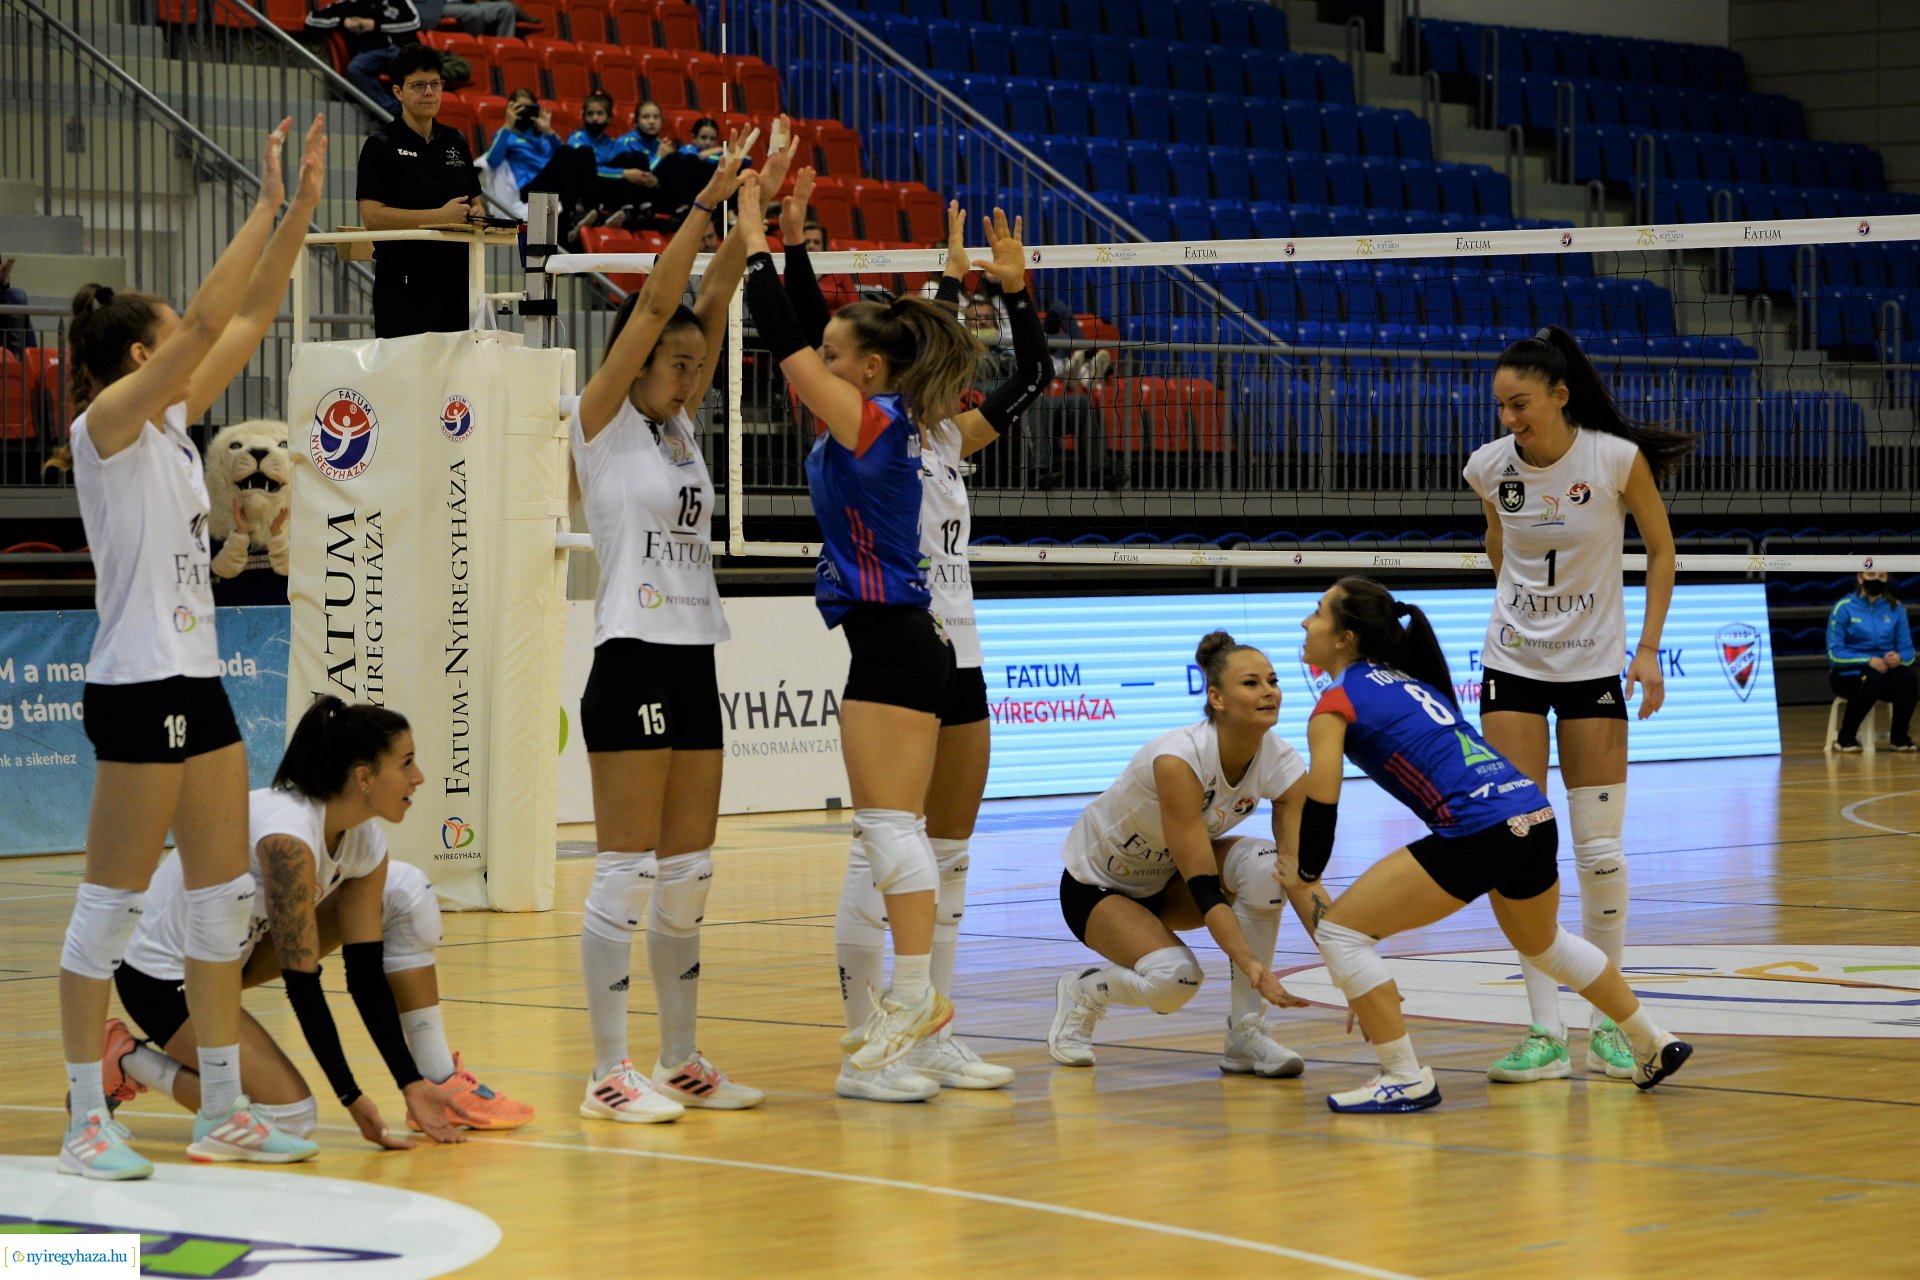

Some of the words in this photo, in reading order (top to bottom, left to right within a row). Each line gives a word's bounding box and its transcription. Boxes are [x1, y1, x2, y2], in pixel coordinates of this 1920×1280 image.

[338, 389, 372, 416] FATUM
[678, 485, 704, 527] 15
[941, 519, 963, 557] 12
[1544, 548, 1558, 587] 1
[311, 507, 358, 701] ATUM
[362, 508, 385, 710] YÍREGYHÁZA
[1509, 583, 1595, 614] FATUM
[1523, 636, 1596, 649] NYÍREGYHÁZA
[23, 664, 40, 683] a
[1005, 662, 1082, 690] FATUM
[637, 702, 667, 736] 15
[988, 693, 1117, 725] YÍREGYHÁZA
[1403, 683, 1456, 726] 8
[164, 714, 188, 749] 19
[26, 752, 77, 767] sikerhez
[433, 852, 482, 861] NYÍREGYHÁZA
